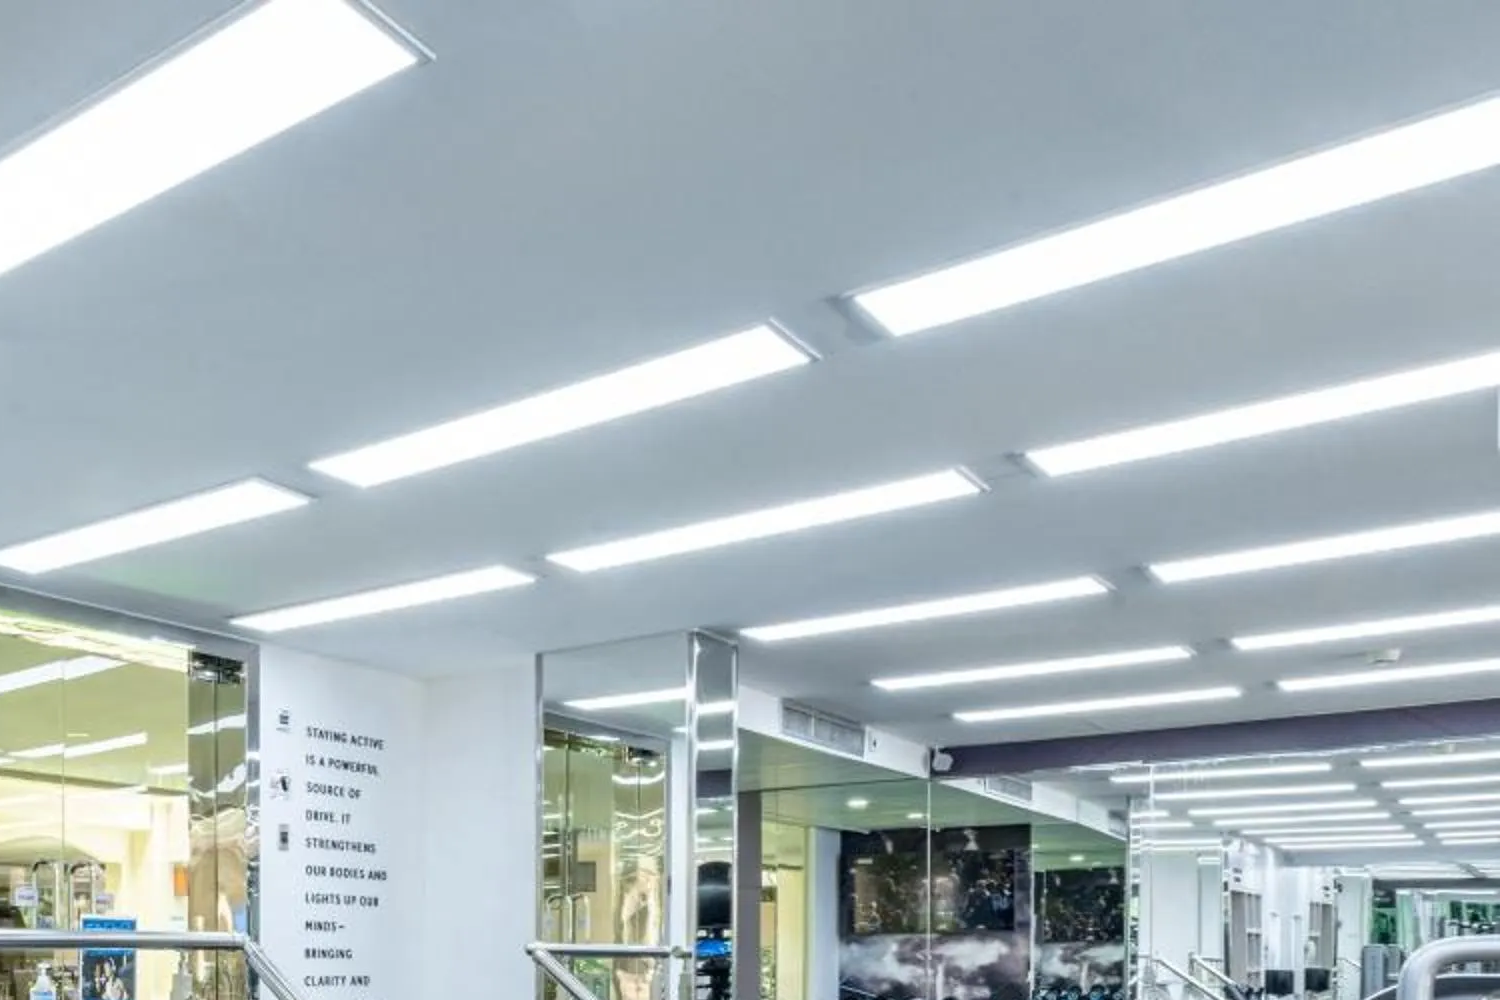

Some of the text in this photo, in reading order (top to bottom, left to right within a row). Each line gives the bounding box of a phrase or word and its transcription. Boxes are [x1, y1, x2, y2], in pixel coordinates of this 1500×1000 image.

[306, 726, 384, 750] STAYING ACTIVE
[305, 754, 378, 776] IS A POWERFUL
[306, 782, 363, 800] SOURCE OF
[341, 813, 351, 825] IT
[305, 838, 376, 854] STRENGTHENS
[305, 865, 387, 881] OUR BODIES AND
[305, 892, 379, 907] LIGHTS UP OUR
[304, 947, 353, 959] BRINGING
[303, 975, 371, 987] CLARITY AND
